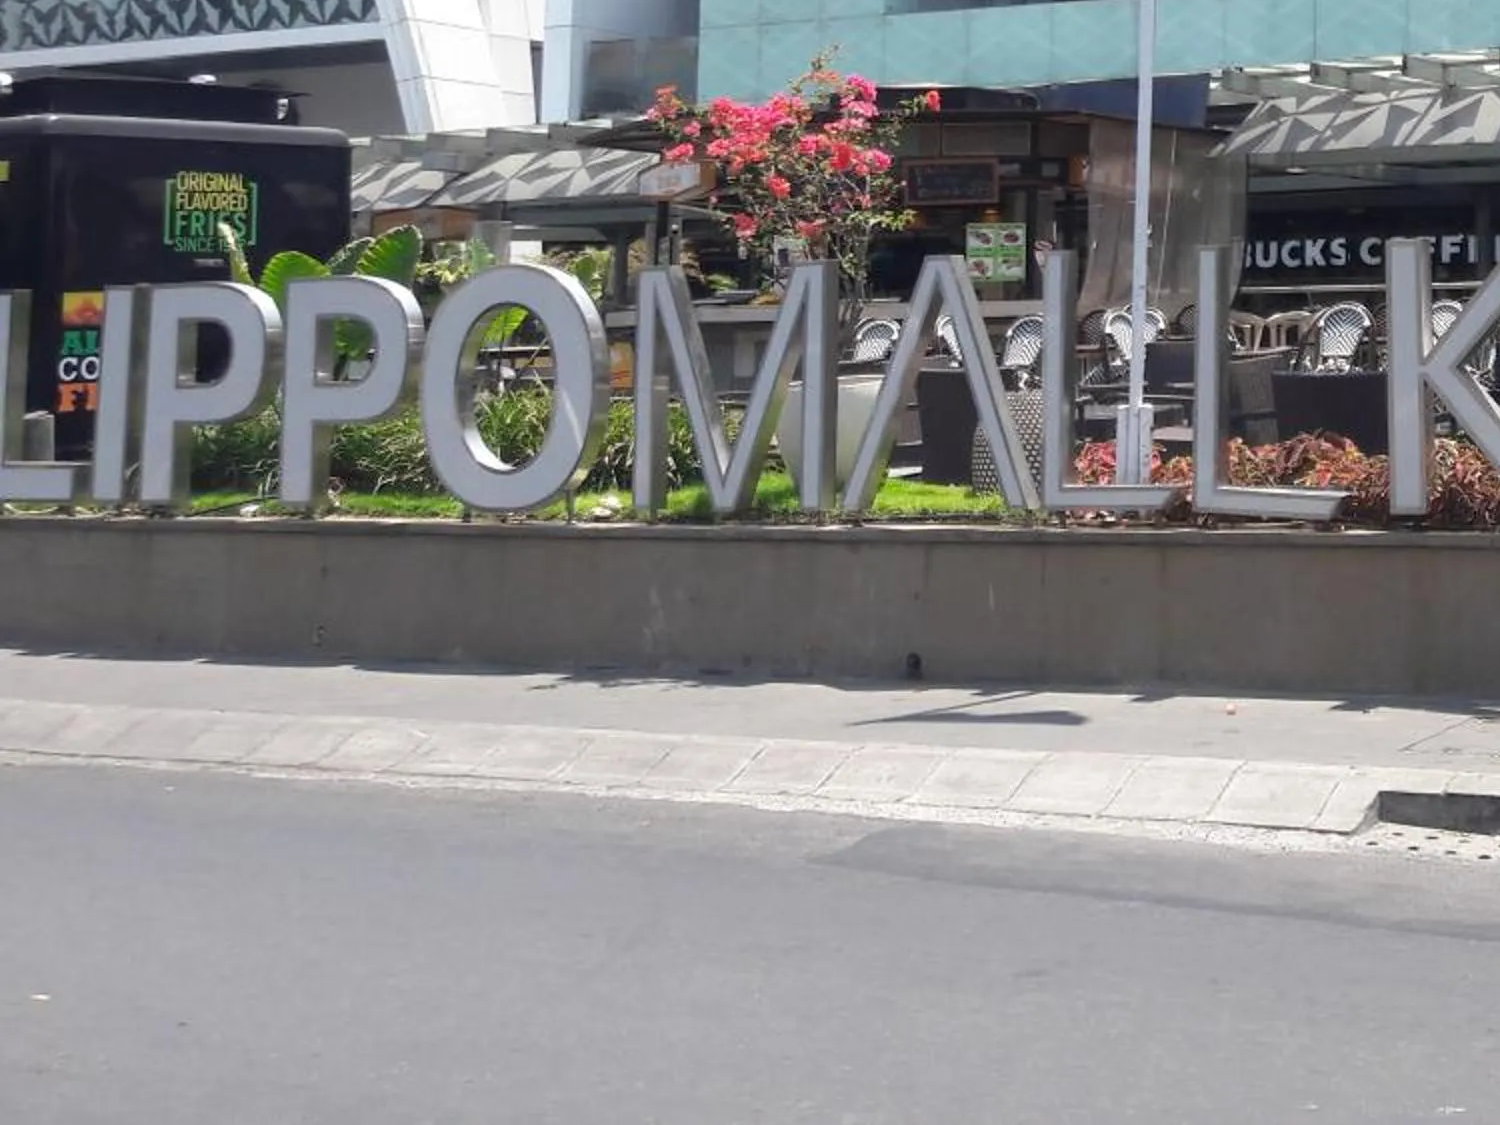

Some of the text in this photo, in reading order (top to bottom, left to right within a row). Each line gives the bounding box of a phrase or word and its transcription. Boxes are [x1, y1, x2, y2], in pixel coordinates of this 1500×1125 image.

[176, 171, 247, 192] ORIGINAL
[176, 192, 248, 211] FLAVORED
[175, 236, 216, 252] SINCE
